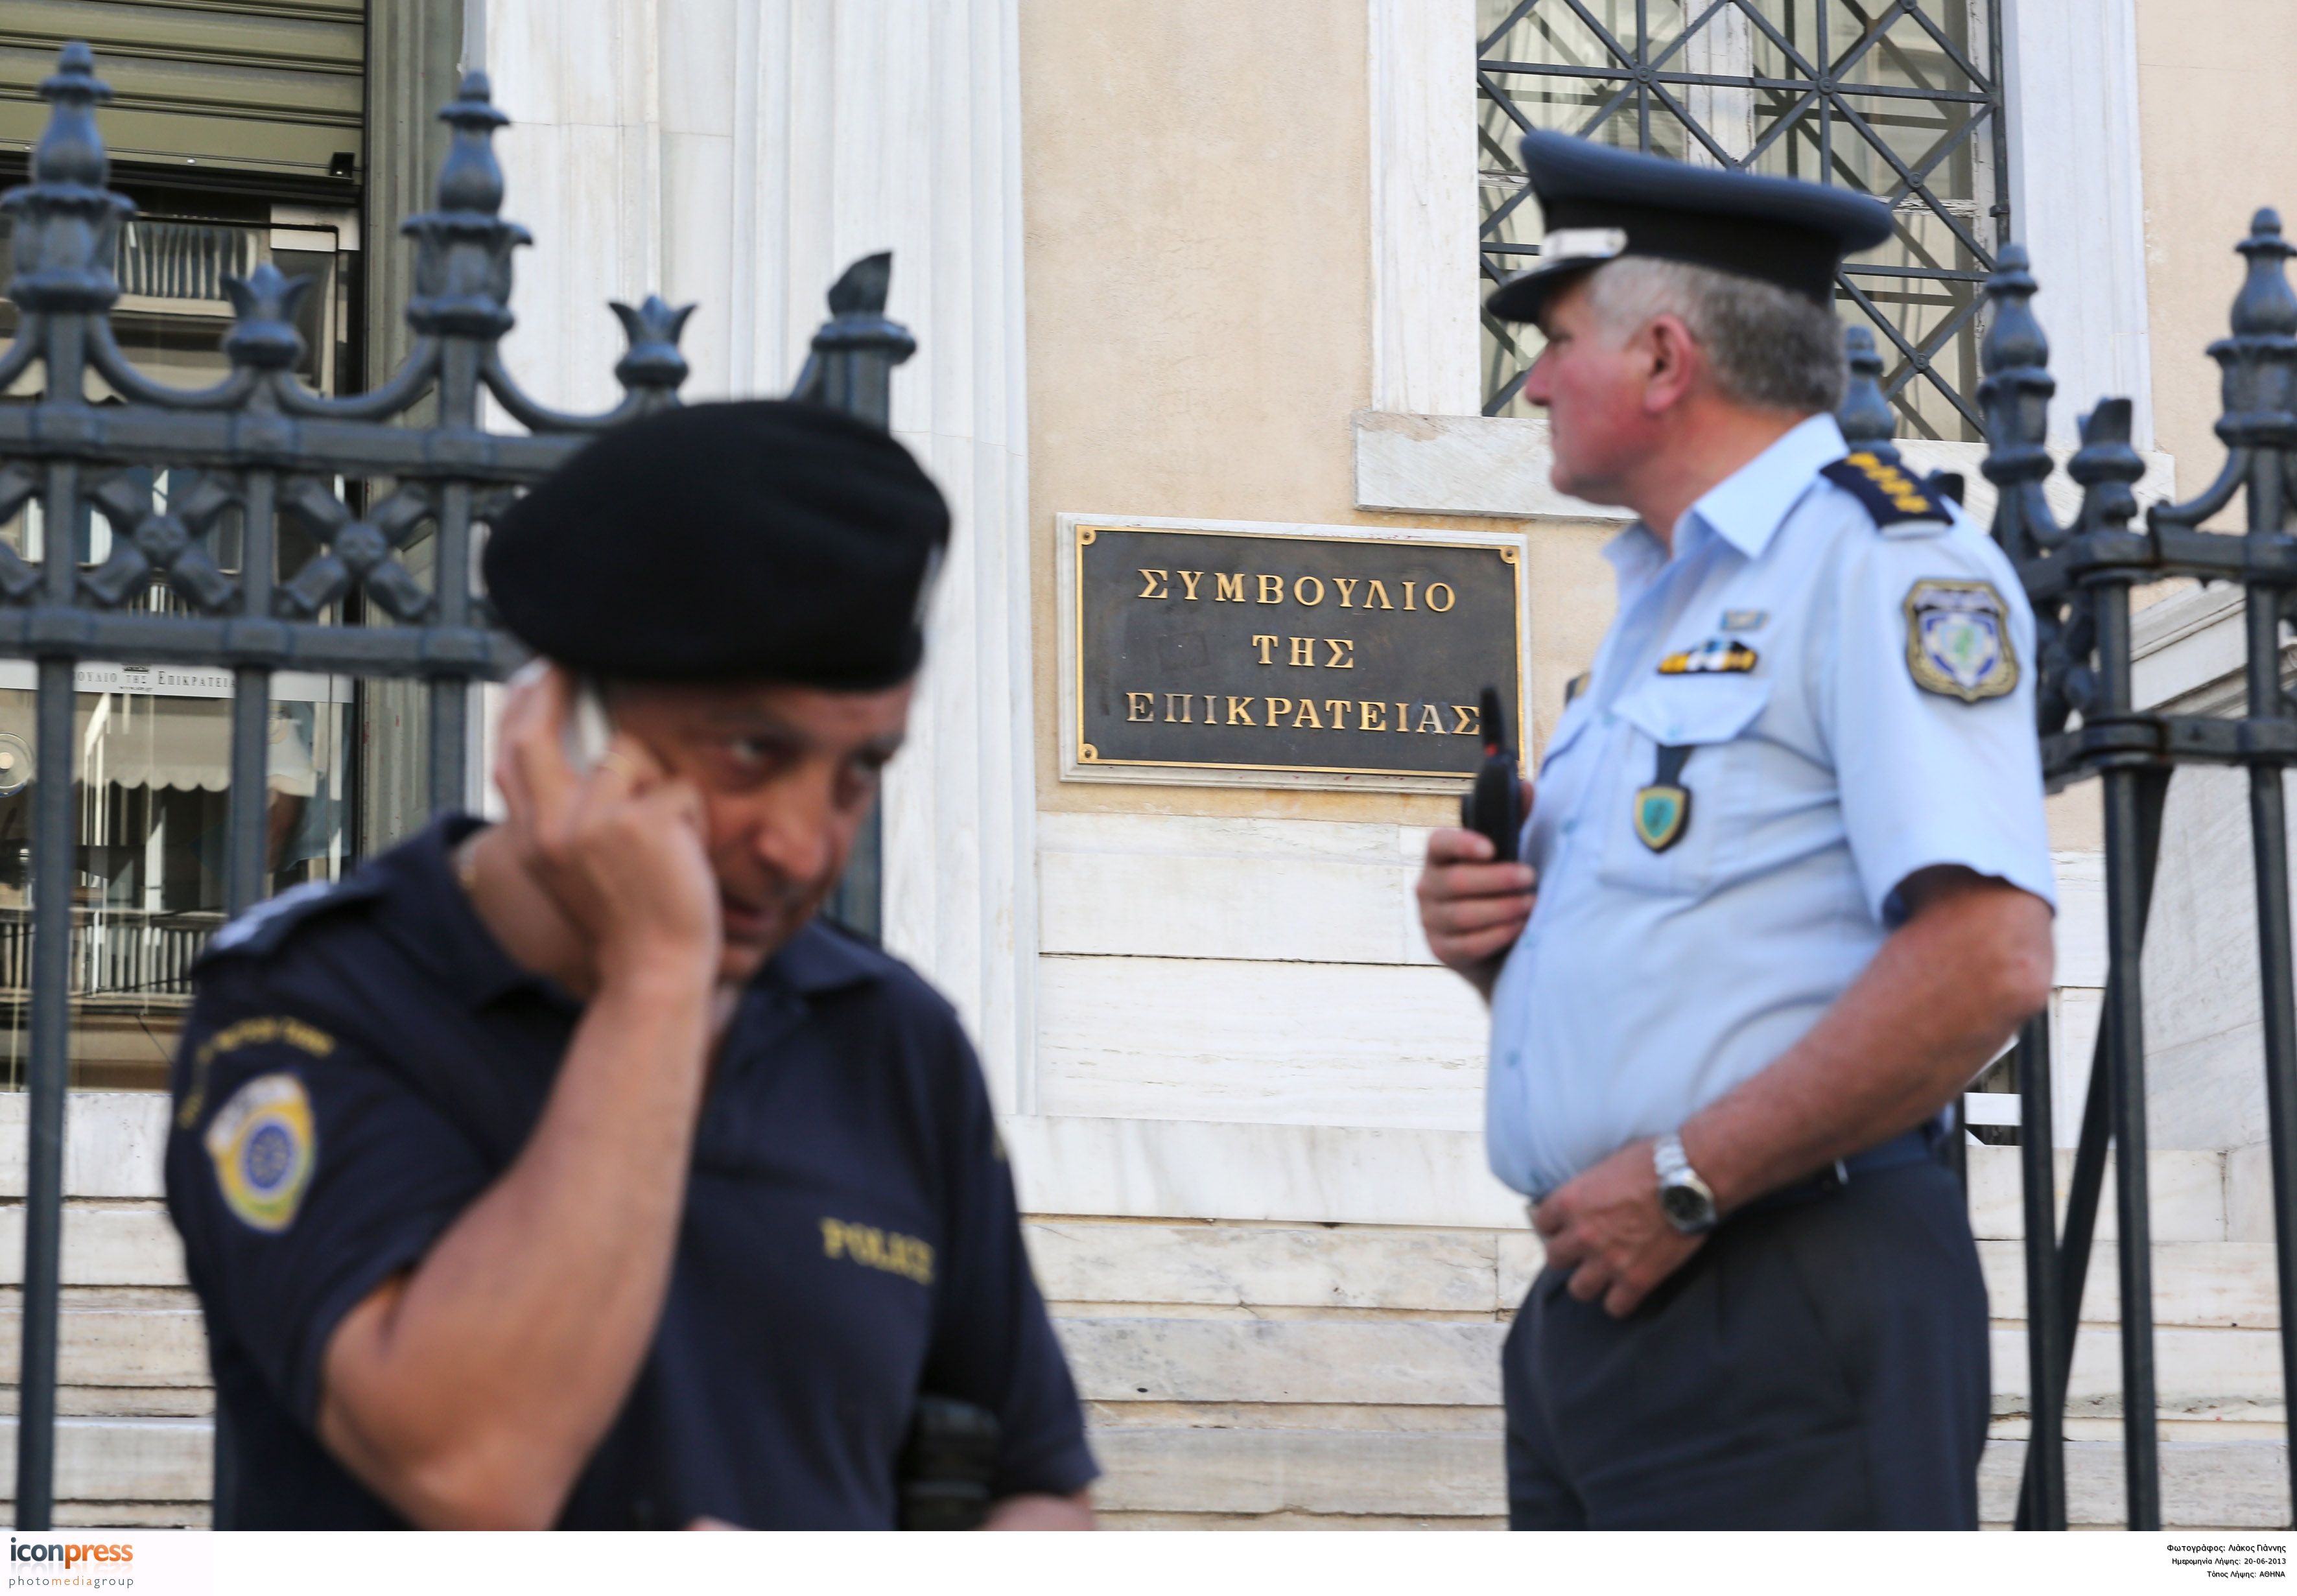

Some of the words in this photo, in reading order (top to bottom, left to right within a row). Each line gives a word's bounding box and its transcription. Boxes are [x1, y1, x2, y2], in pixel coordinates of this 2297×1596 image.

[1138, 569, 1455, 613] ΣΥΜΒΟΥΛΙΟ
[1252, 635, 1354, 669] ΤΗΣ
[1126, 692, 1480, 735] ΕΠΙΚΡΑΤΕΙΑΣ
